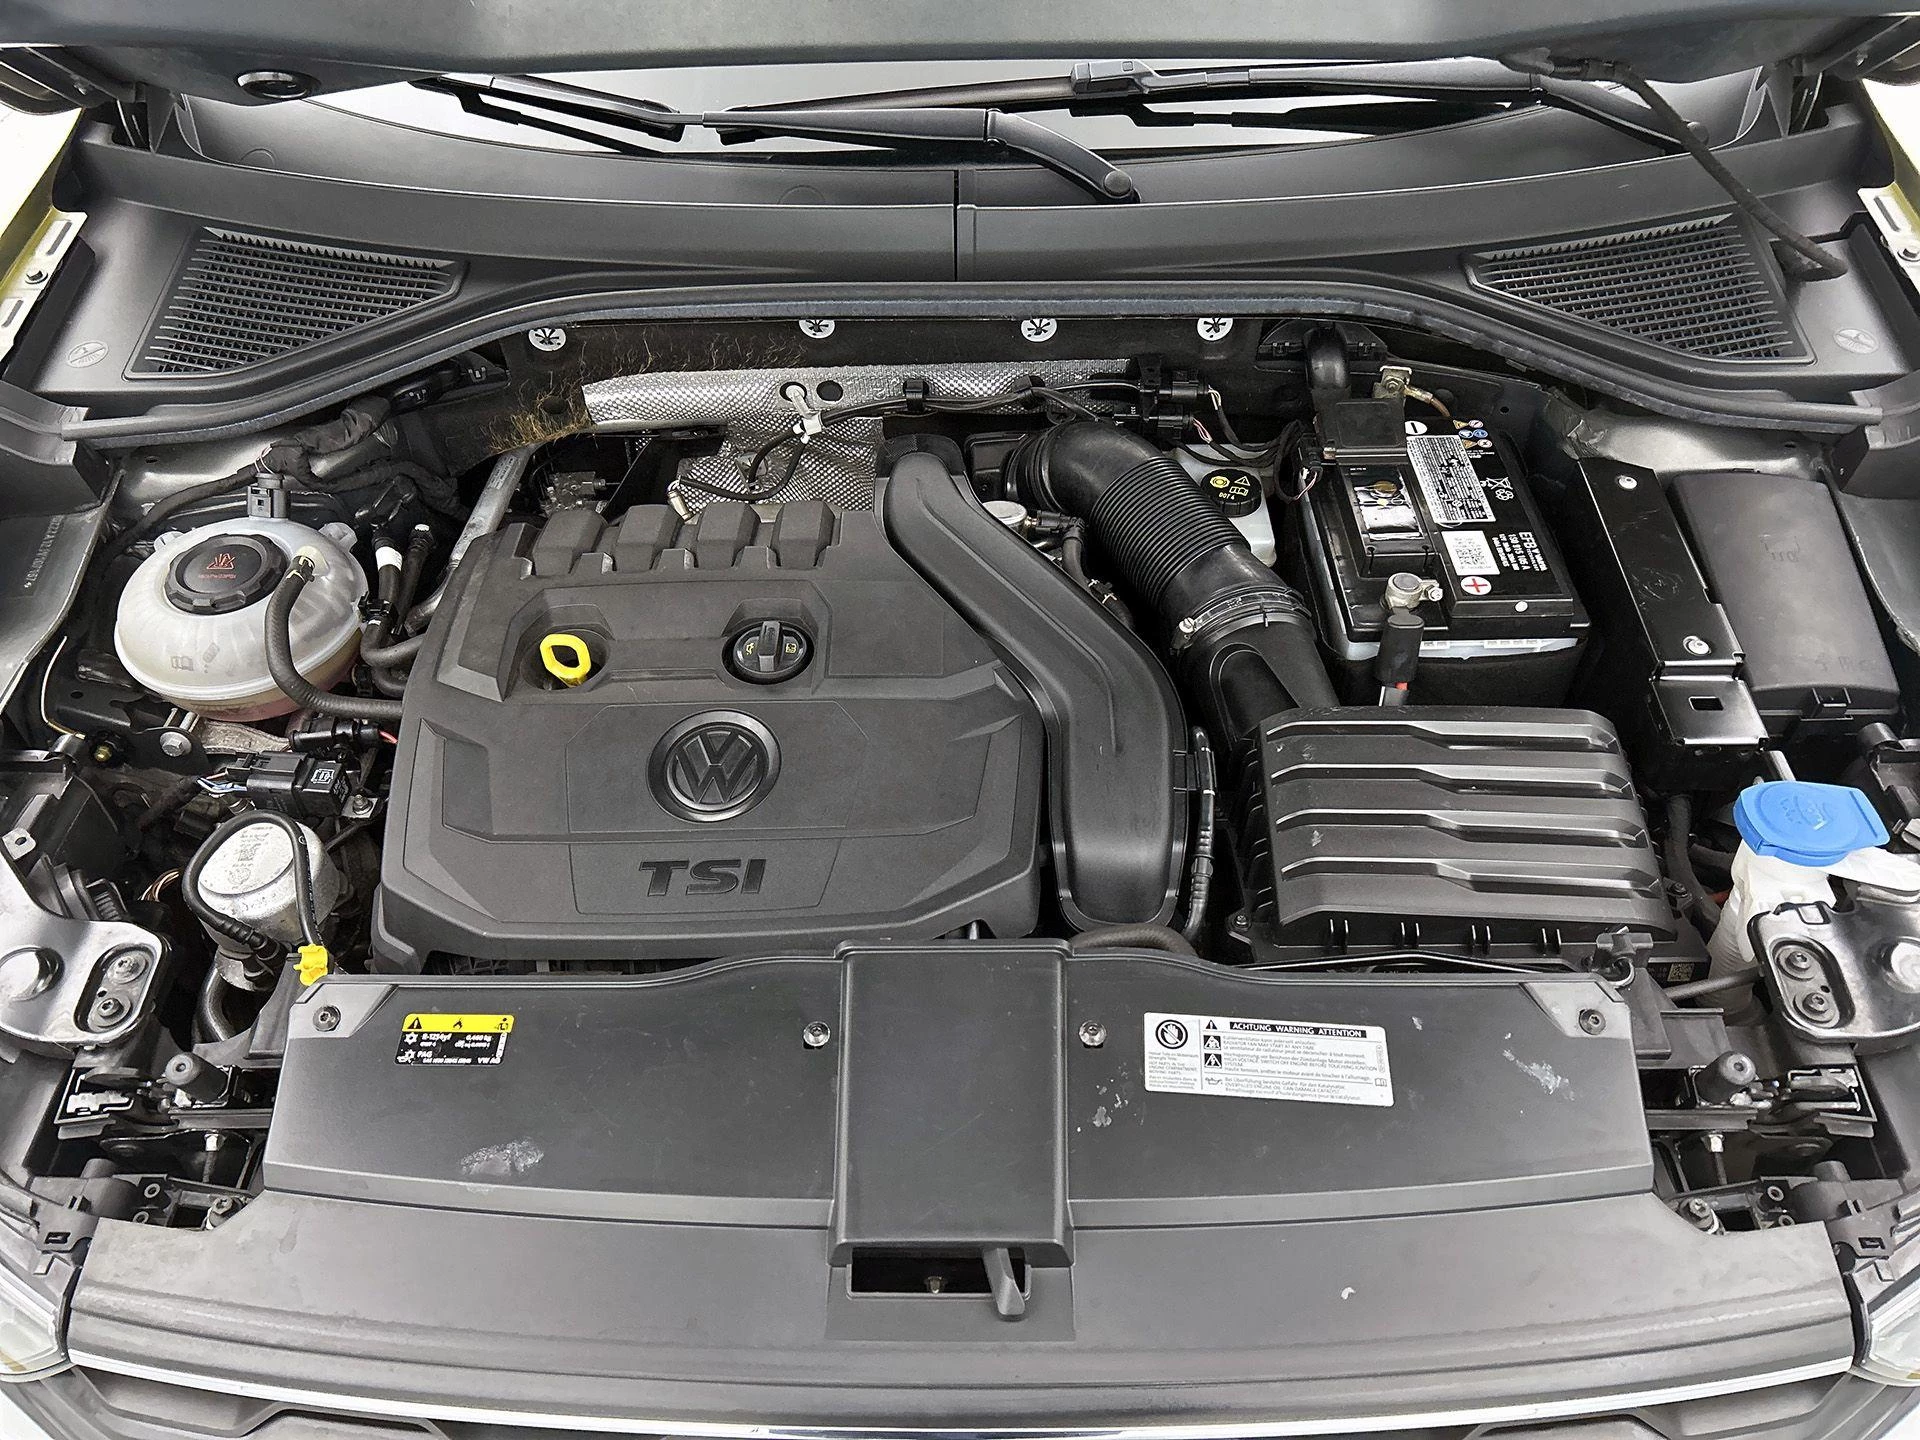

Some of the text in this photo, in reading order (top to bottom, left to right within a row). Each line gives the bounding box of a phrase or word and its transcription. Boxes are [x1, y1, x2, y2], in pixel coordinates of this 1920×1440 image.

[1518, 532, 1537, 548] EFB
[638, 858, 767, 897] TSI
[1232, 1022, 1362, 1037] ACHTUNG WARNING ATTENTION
